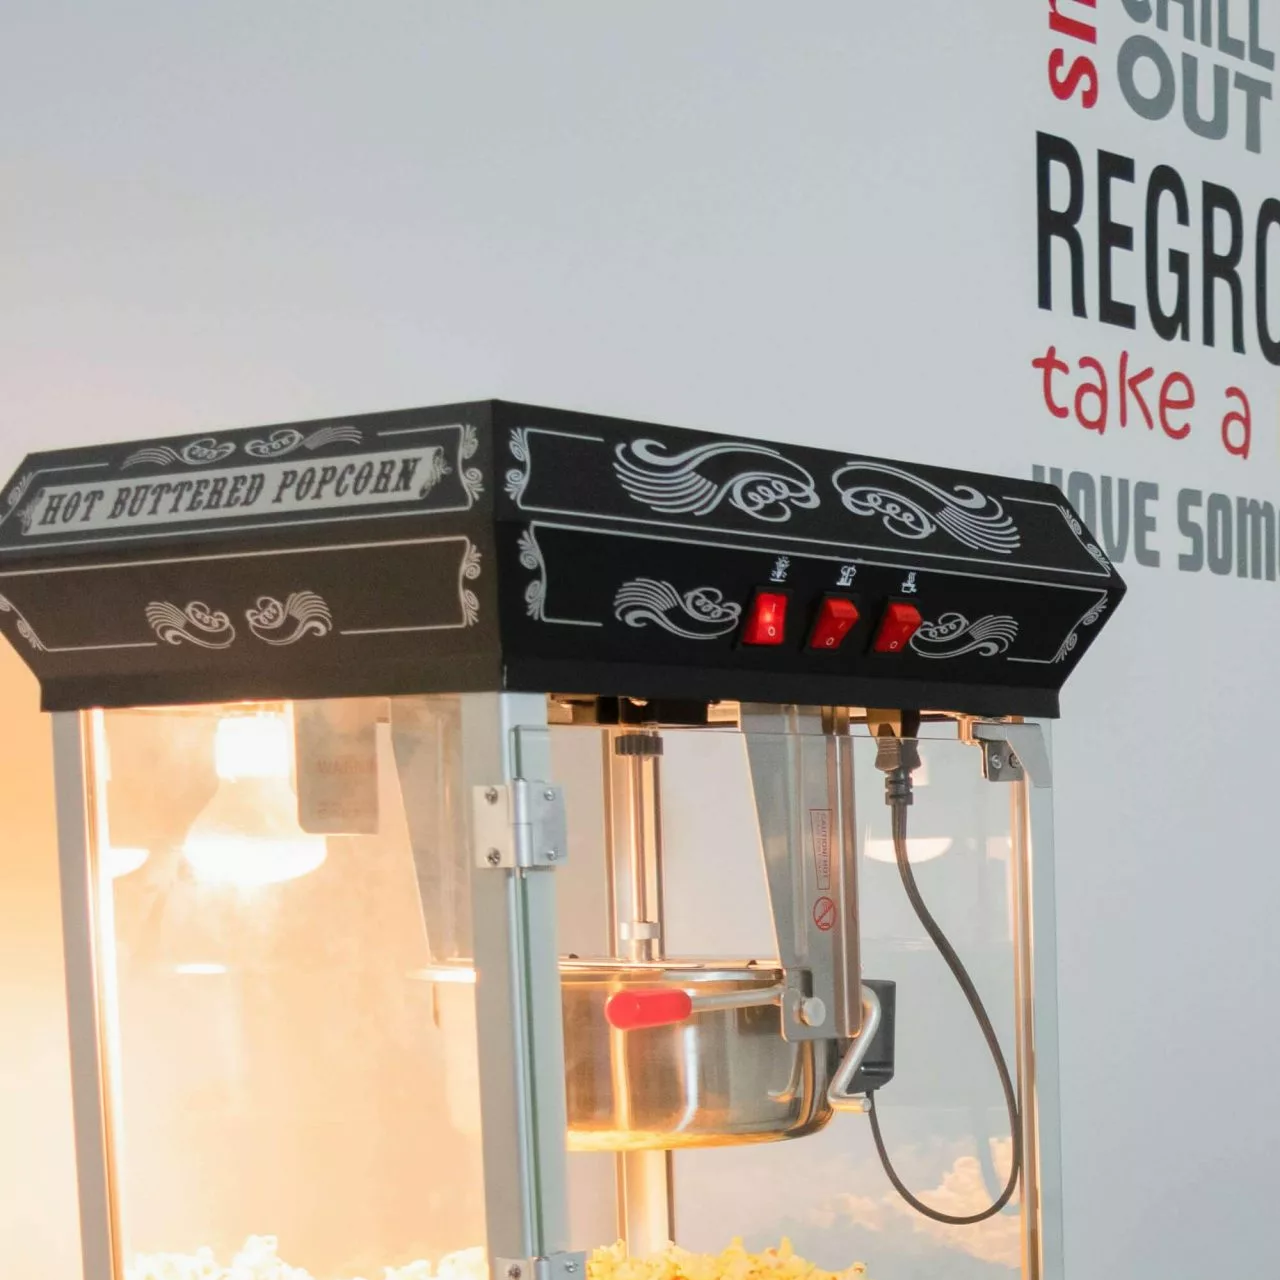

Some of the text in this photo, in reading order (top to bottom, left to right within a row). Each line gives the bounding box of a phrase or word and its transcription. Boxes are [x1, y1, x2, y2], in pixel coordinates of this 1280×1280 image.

[1117, 34, 1273, 154] OUT
[1031, 345, 1196, 440] take
[1221, 386, 1252, 460] a
[38, 456, 421, 525] HOT BUTTERED POPCORN
